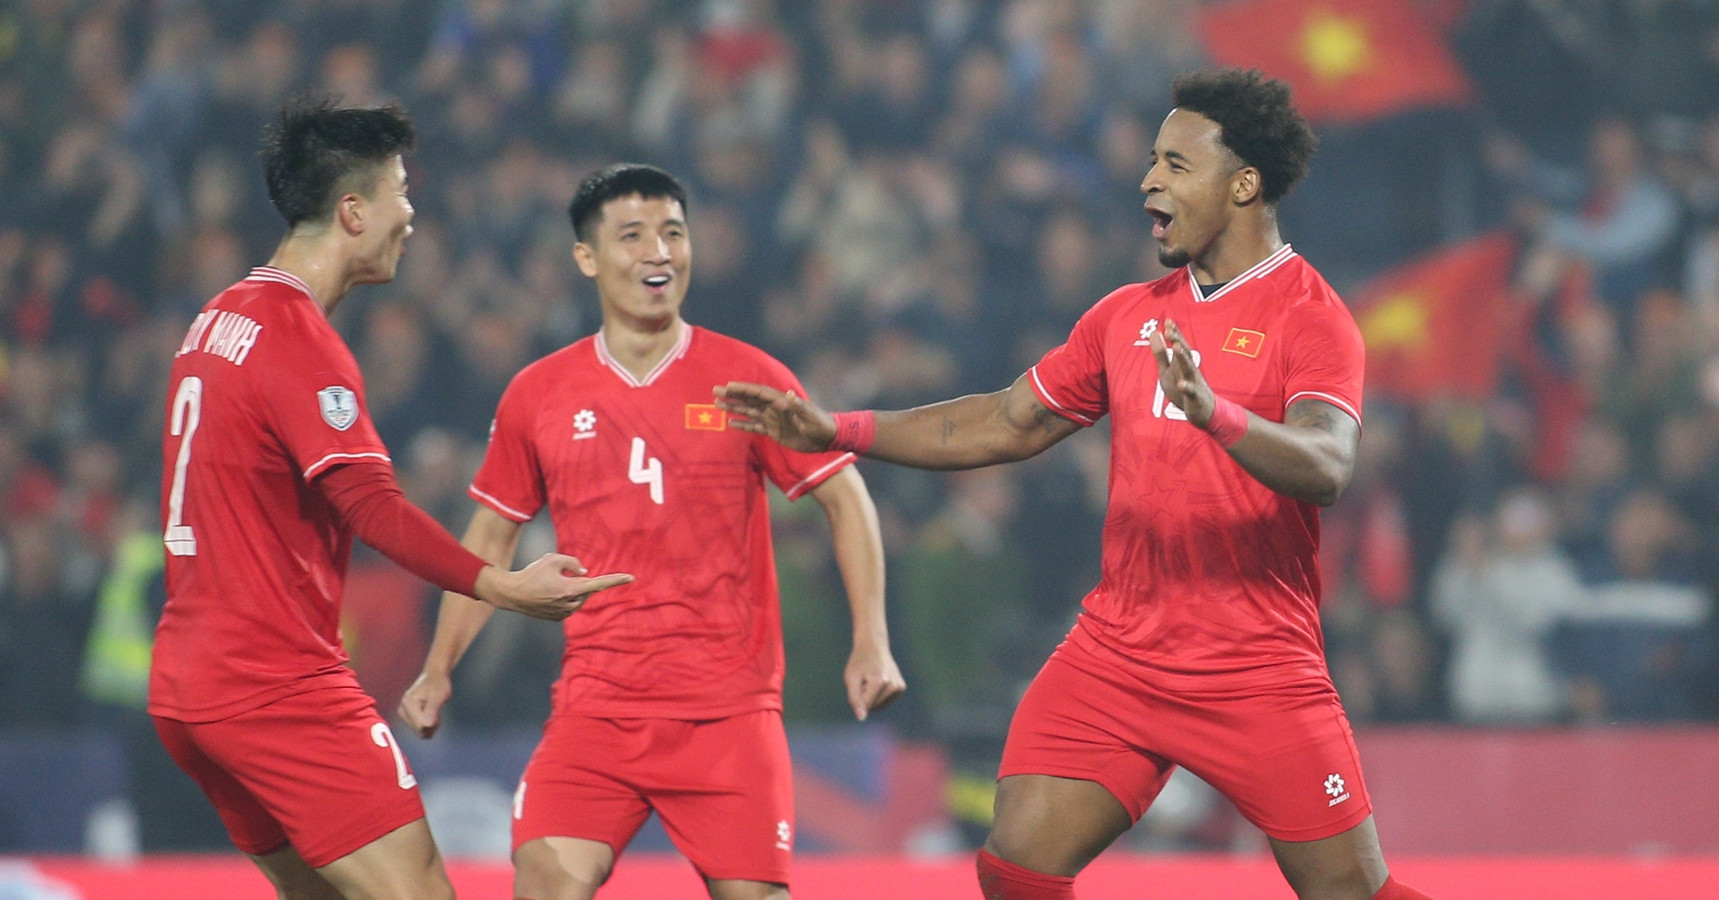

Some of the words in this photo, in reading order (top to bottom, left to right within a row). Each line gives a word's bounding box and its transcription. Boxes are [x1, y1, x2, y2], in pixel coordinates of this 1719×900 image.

[203, 311, 263, 366] MANH
[164, 376, 203, 556] 2
[628, 436, 664, 505] 4
[370, 722, 418, 790] 2
